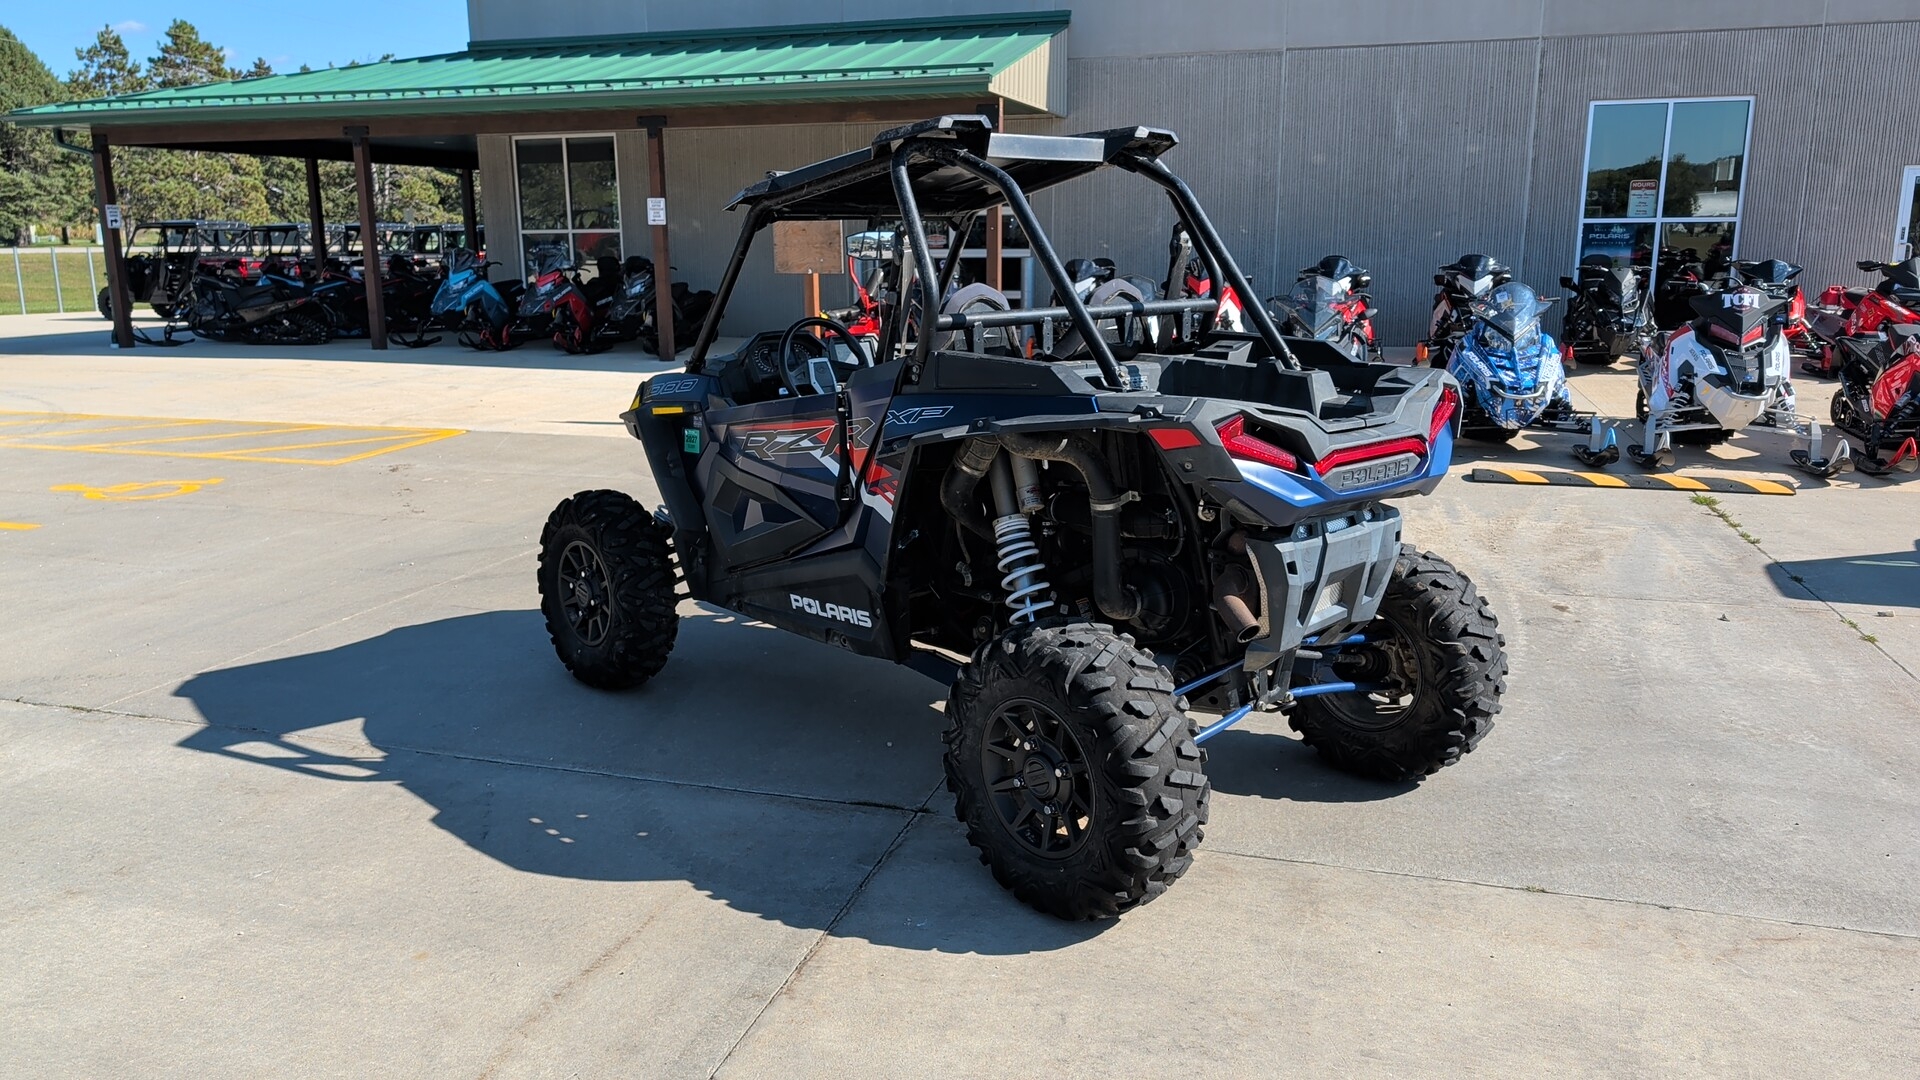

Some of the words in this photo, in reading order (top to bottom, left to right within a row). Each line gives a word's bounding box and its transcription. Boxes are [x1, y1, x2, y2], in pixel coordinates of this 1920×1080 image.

[1722, 293, 1760, 309] TCFI
[1468, 351, 1494, 377] POLARIS
[884, 405, 954, 426] XP
[742, 416, 876, 461] RZR
[1341, 458, 1410, 487] POLARIS
[789, 593, 873, 628] POLARIS
